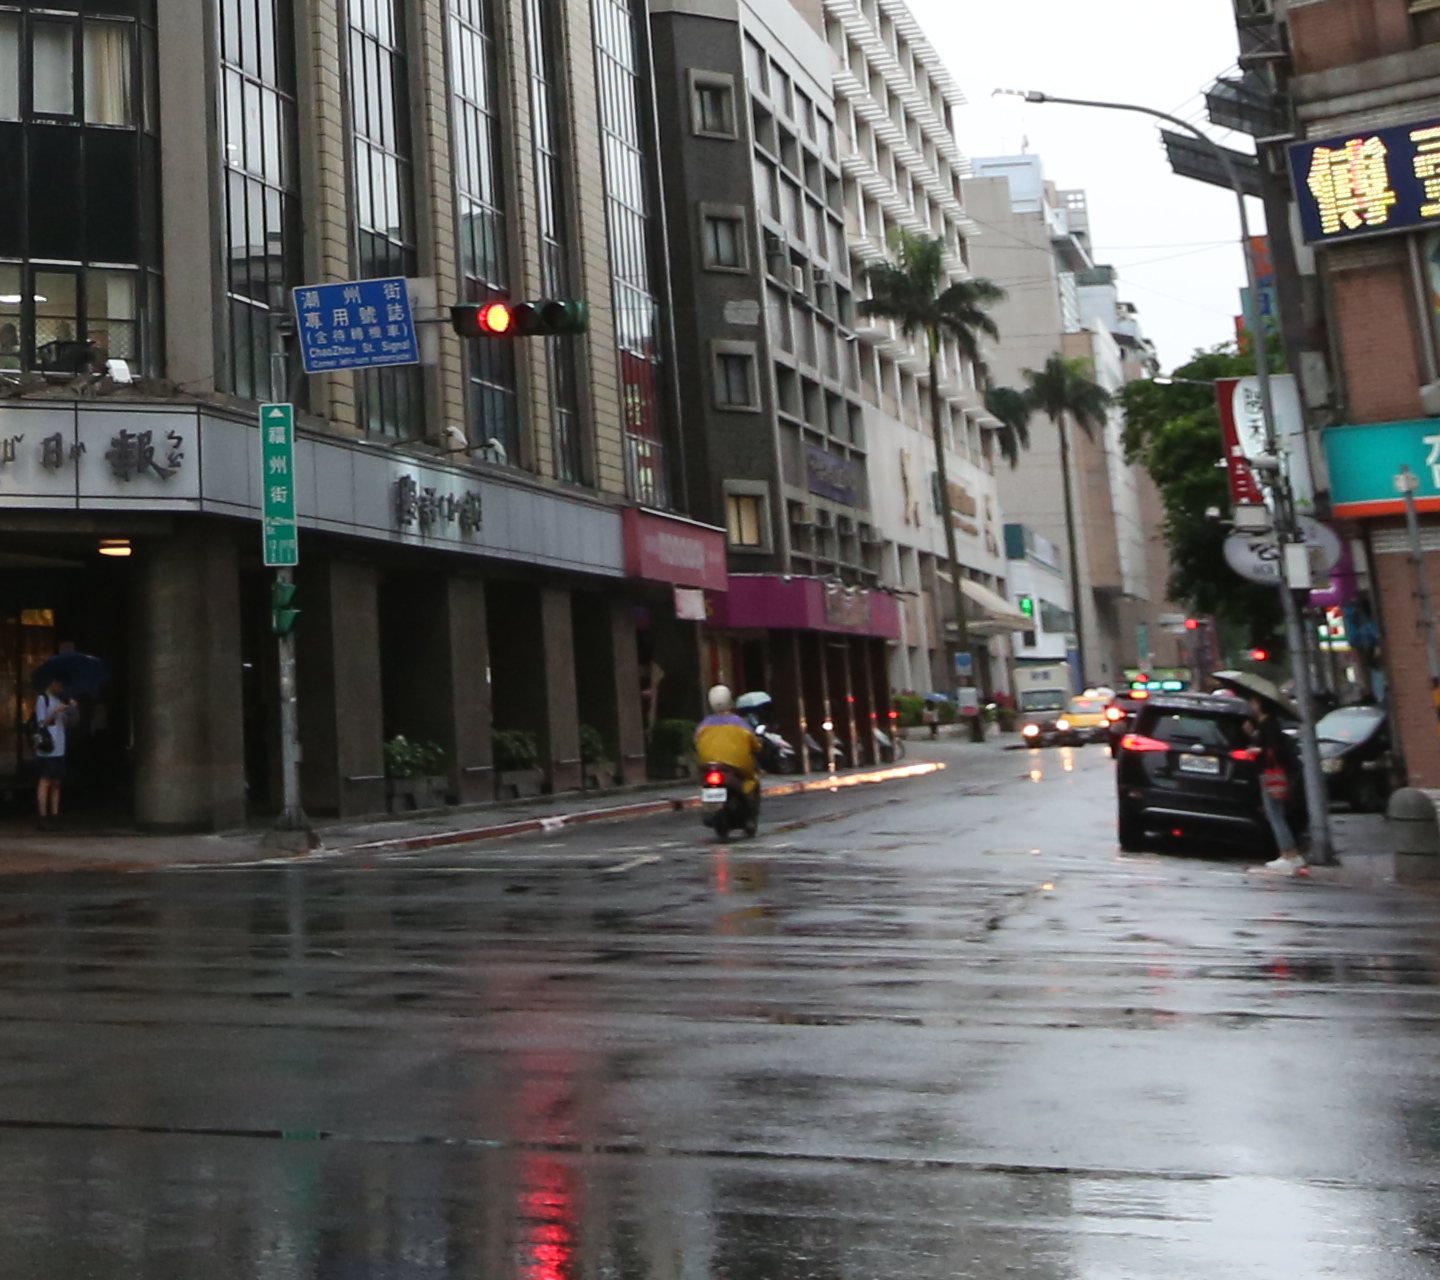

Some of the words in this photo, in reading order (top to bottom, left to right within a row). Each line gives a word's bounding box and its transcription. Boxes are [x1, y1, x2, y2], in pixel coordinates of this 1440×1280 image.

[300, 282, 401, 310] 潮州街
[304, 303, 405, 330] 專用號誌
[268, 426, 288, 504] 福州街
